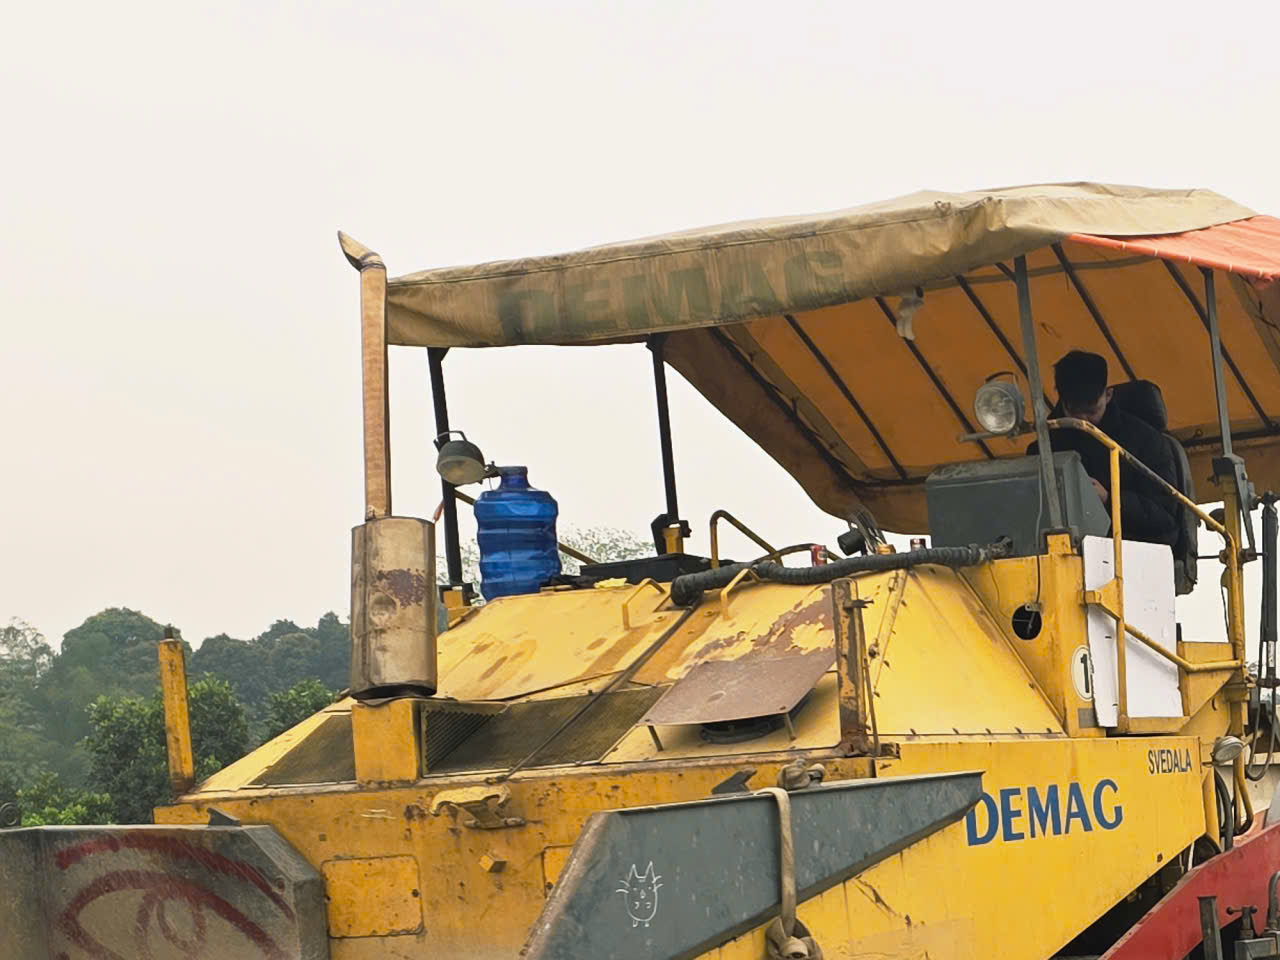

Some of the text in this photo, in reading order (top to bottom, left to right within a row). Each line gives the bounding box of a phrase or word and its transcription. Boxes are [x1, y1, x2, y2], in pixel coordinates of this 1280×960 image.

[1080, 653, 1090, 694] 1
[1148, 748, 1193, 774] SVEDALA
[965, 778, 1124, 847] DEMAG
